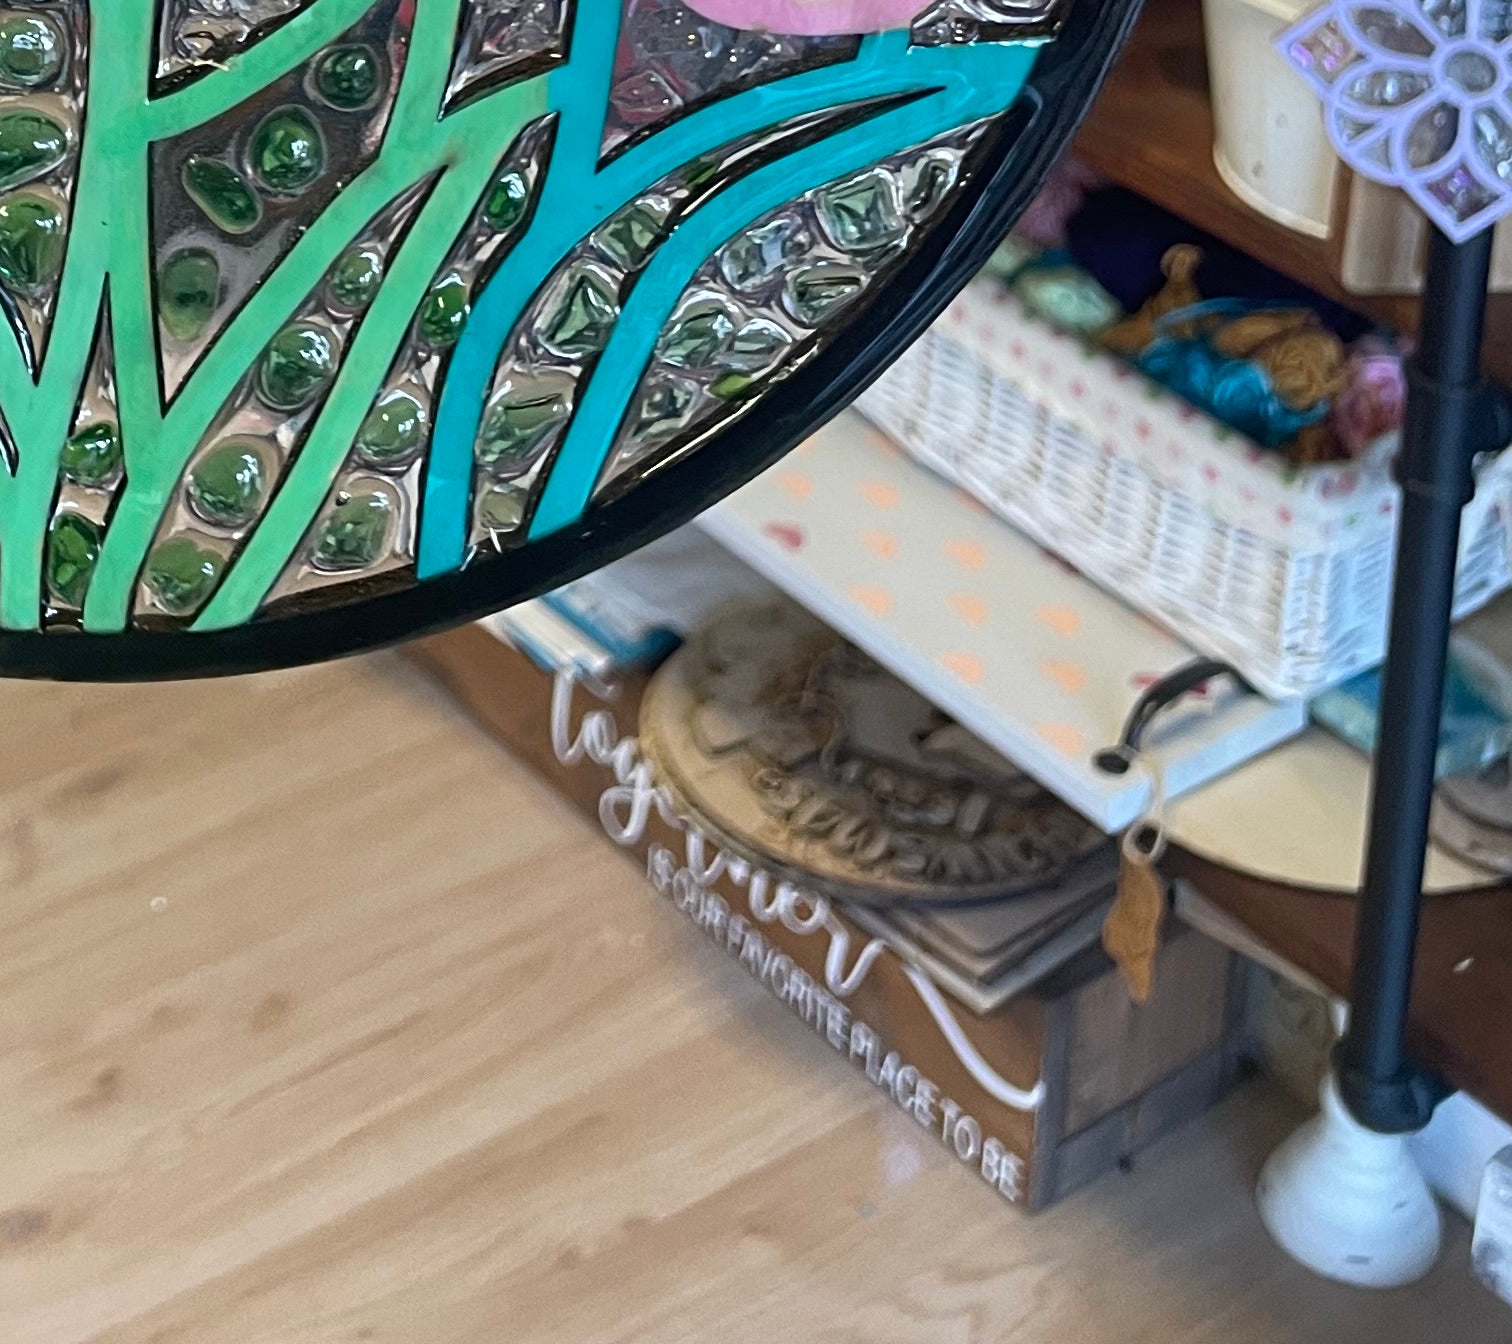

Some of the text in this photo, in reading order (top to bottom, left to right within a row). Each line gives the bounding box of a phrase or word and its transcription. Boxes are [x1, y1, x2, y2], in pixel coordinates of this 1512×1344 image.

[728, 914, 852, 1050] FAVORITE
[849, 1020, 940, 1128] PLACE
[939, 1097, 982, 1162] TO
[982, 1136, 1025, 1202] BE
